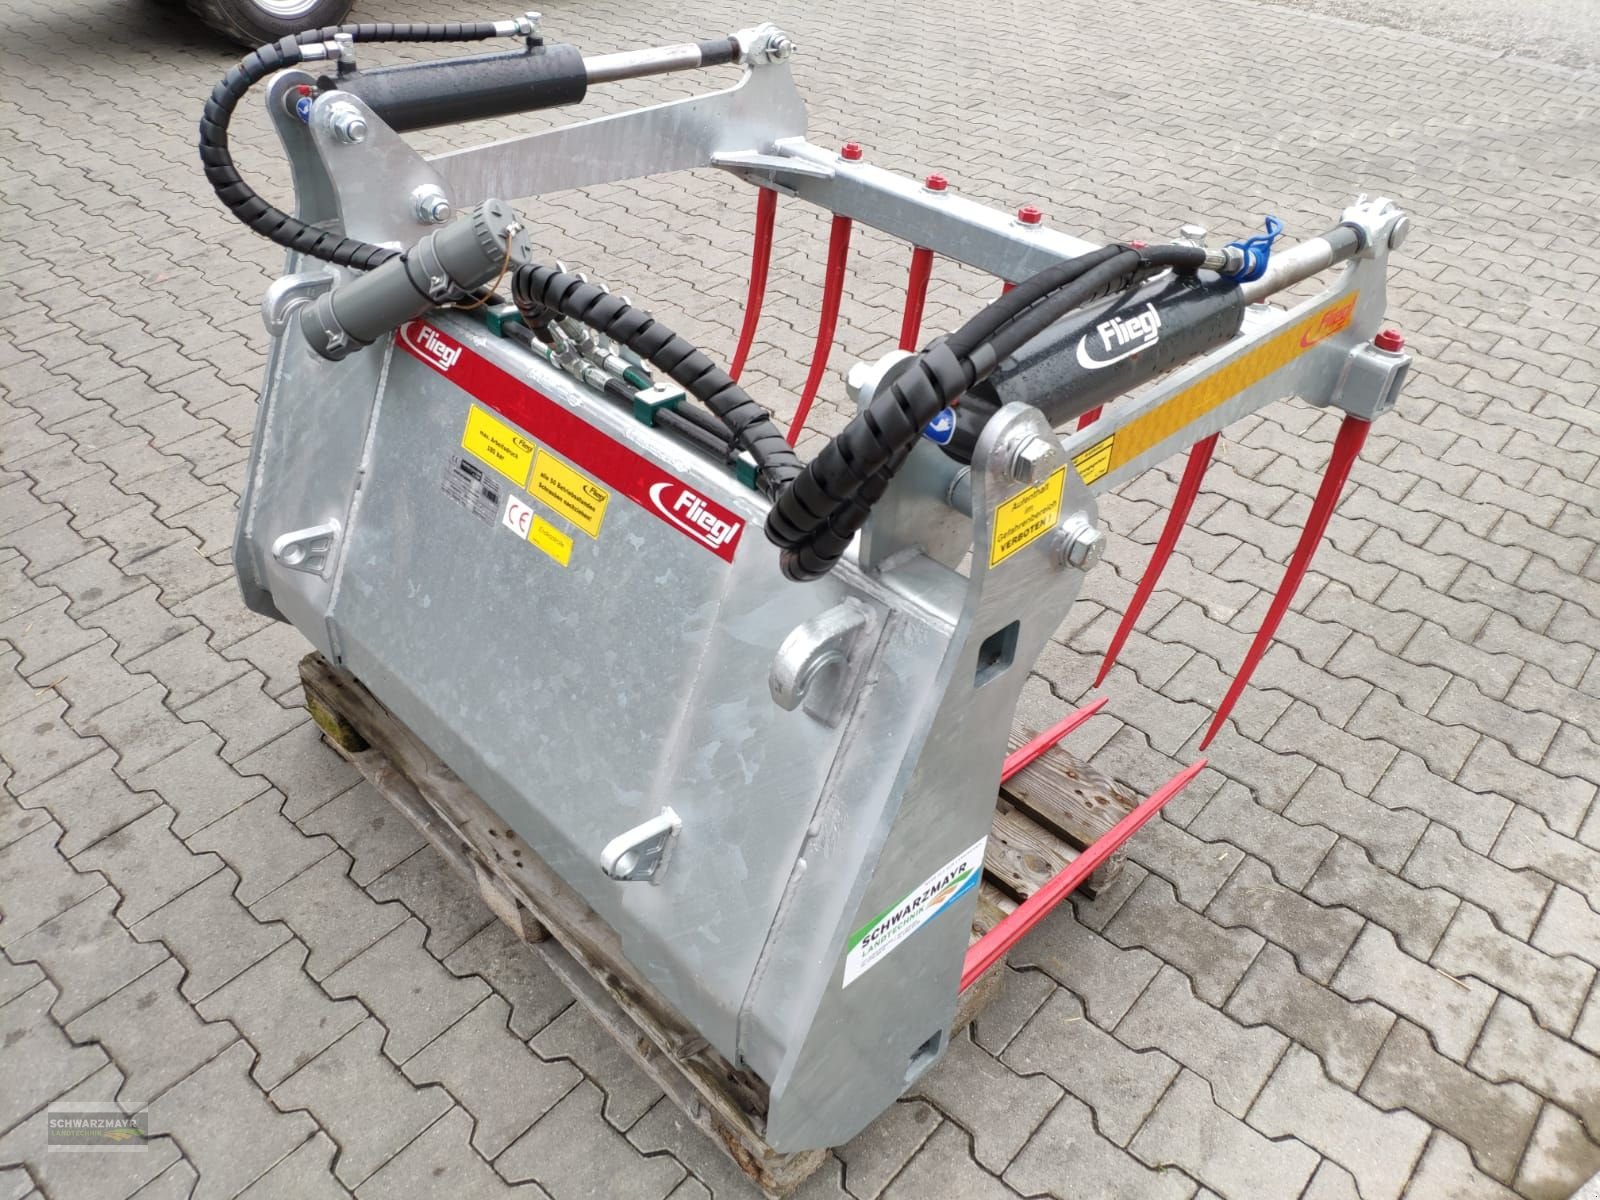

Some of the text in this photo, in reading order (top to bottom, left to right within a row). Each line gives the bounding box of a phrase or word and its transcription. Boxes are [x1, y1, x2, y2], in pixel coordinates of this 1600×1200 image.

[417, 325, 462, 368] Fliegl
[1096, 302, 1161, 352] Fliegl
[673, 489, 741, 546] Fliegl
[861, 861, 968, 949] SCHWARZMAYR
[862, 906, 925, 957] LANDTECHNIK
